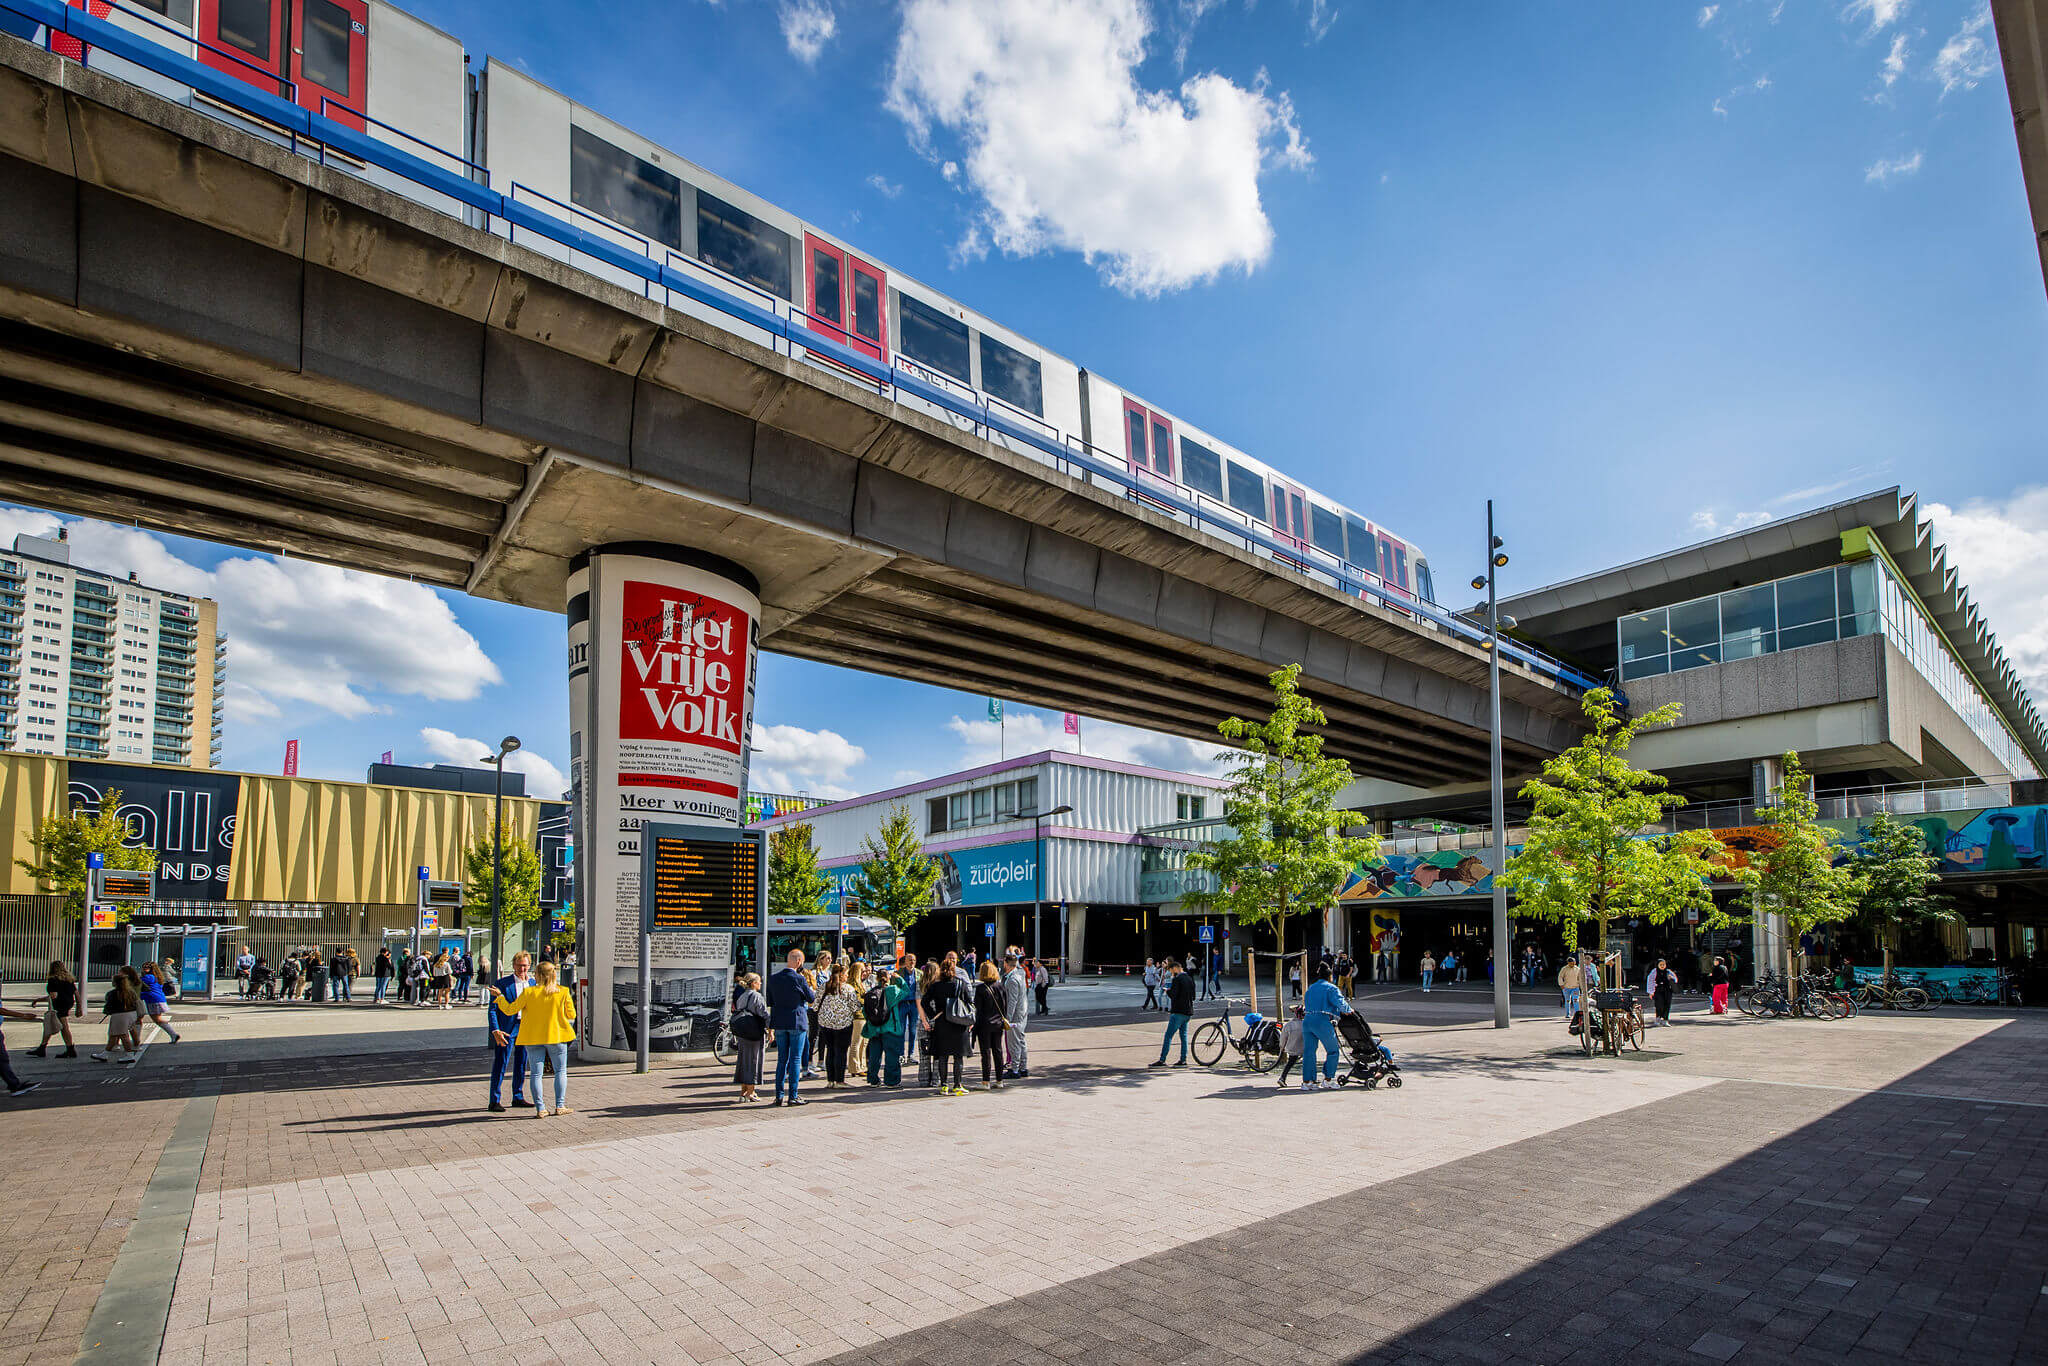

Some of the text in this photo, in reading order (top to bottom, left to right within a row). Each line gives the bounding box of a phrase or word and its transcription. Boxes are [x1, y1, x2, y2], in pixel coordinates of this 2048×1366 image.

[660, 598, 734, 656] Het
[623, 640, 731, 697] Vrije
[639, 687, 740, 745] Volk
[620, 794, 737, 818] Meer woningen
